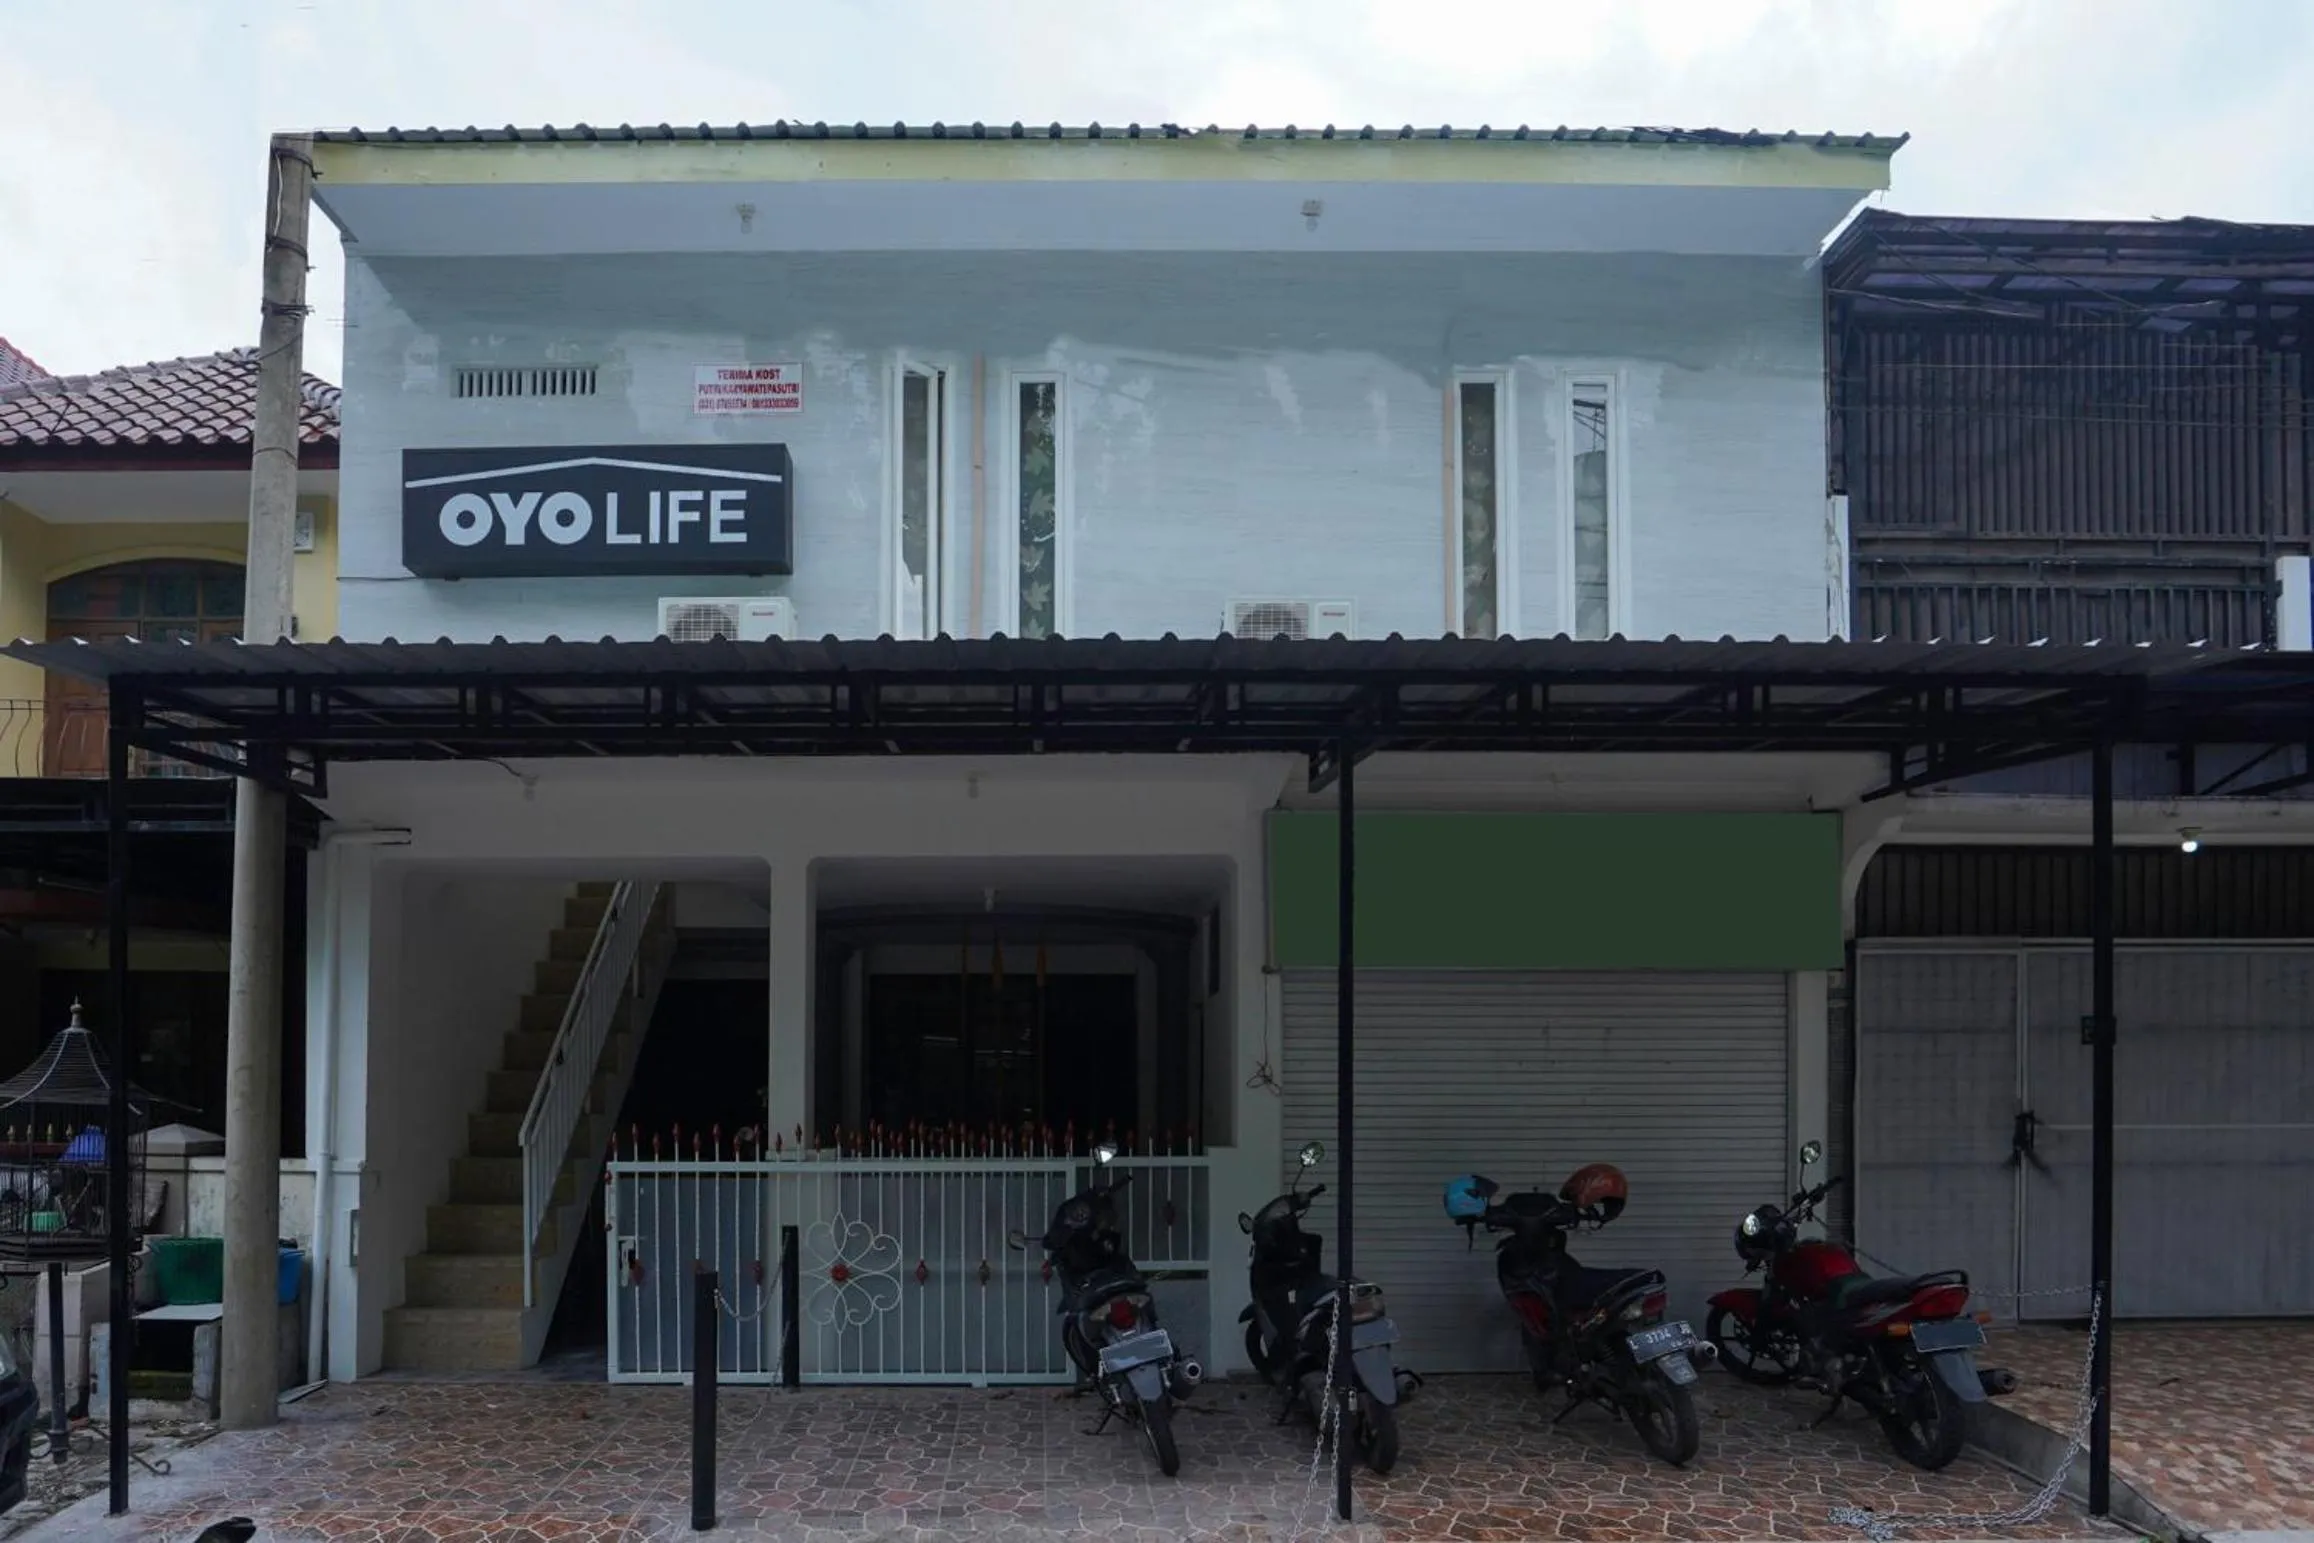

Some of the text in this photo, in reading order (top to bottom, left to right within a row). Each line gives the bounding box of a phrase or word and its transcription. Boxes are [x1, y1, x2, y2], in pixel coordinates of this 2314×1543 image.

[754, 368, 781, 380] KOST
[439, 490, 748, 546] OYO LIFE
